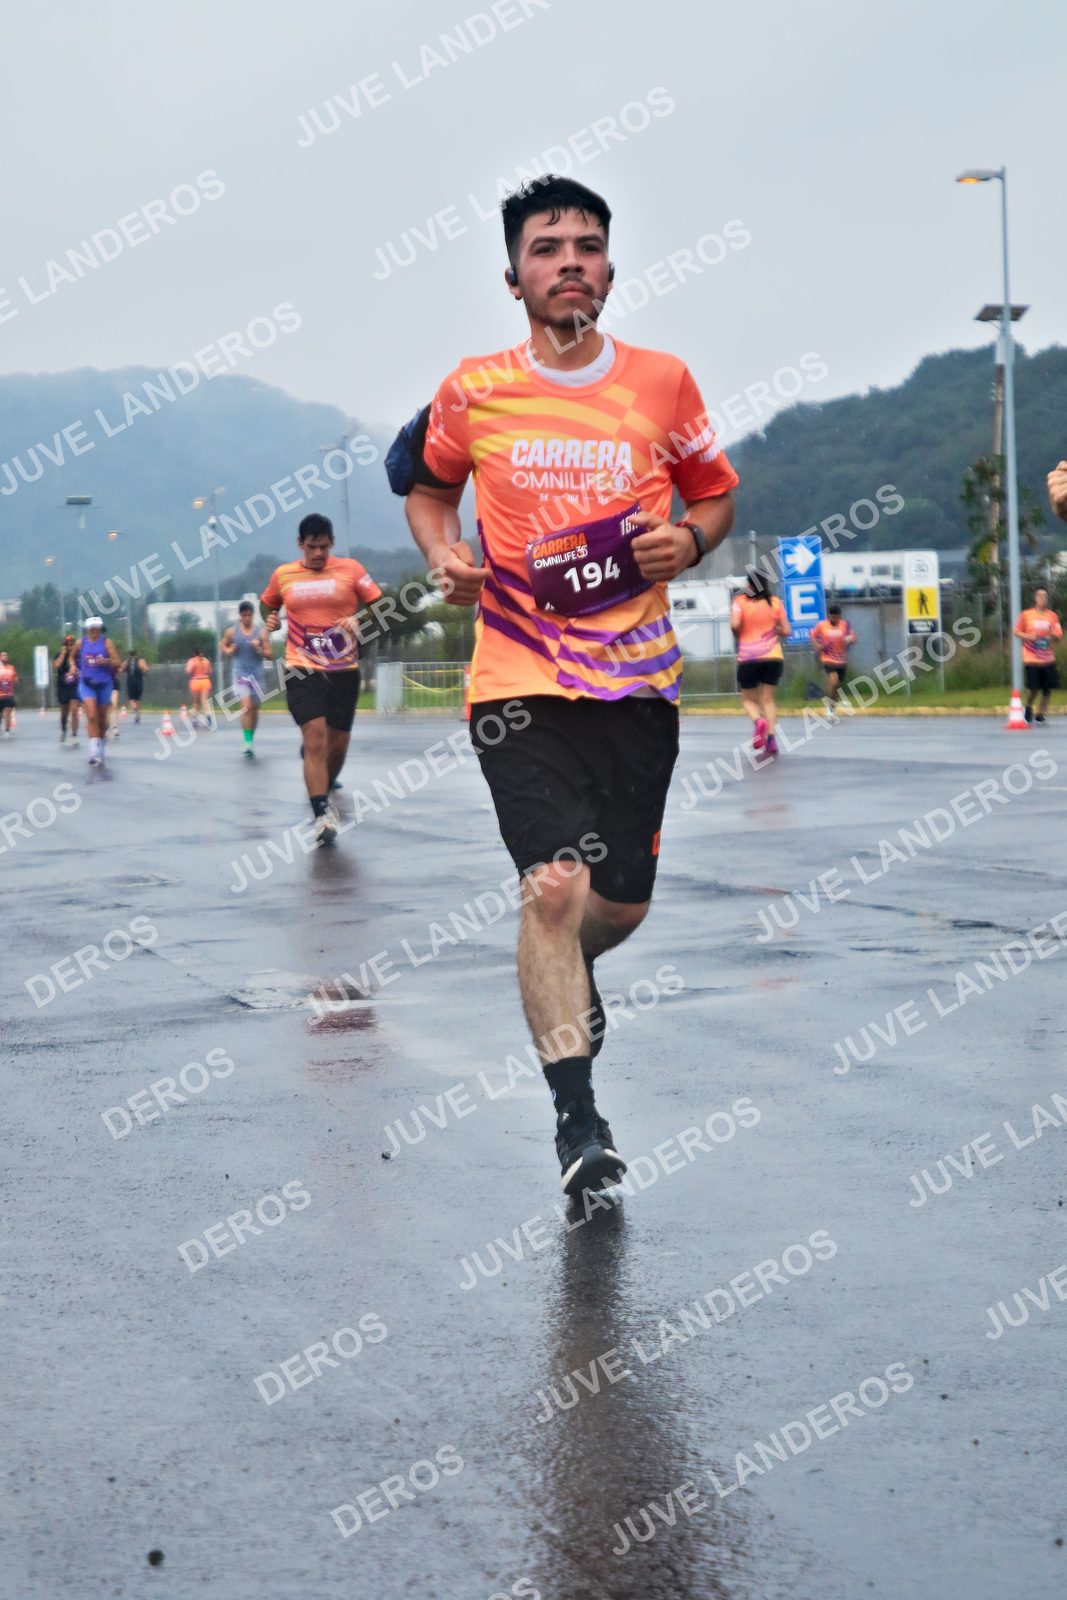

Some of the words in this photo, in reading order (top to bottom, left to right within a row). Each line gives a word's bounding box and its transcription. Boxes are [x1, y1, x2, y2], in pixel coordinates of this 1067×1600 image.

[511, 439, 632, 472] CARRERA
[512, 471, 608, 491] OMNILIFE
[533, 532, 588, 559] CARRERA
[534, 551, 577, 569] OMNILIFE
[563, 555, 621, 593] 194
[791, 583, 819, 620] E
